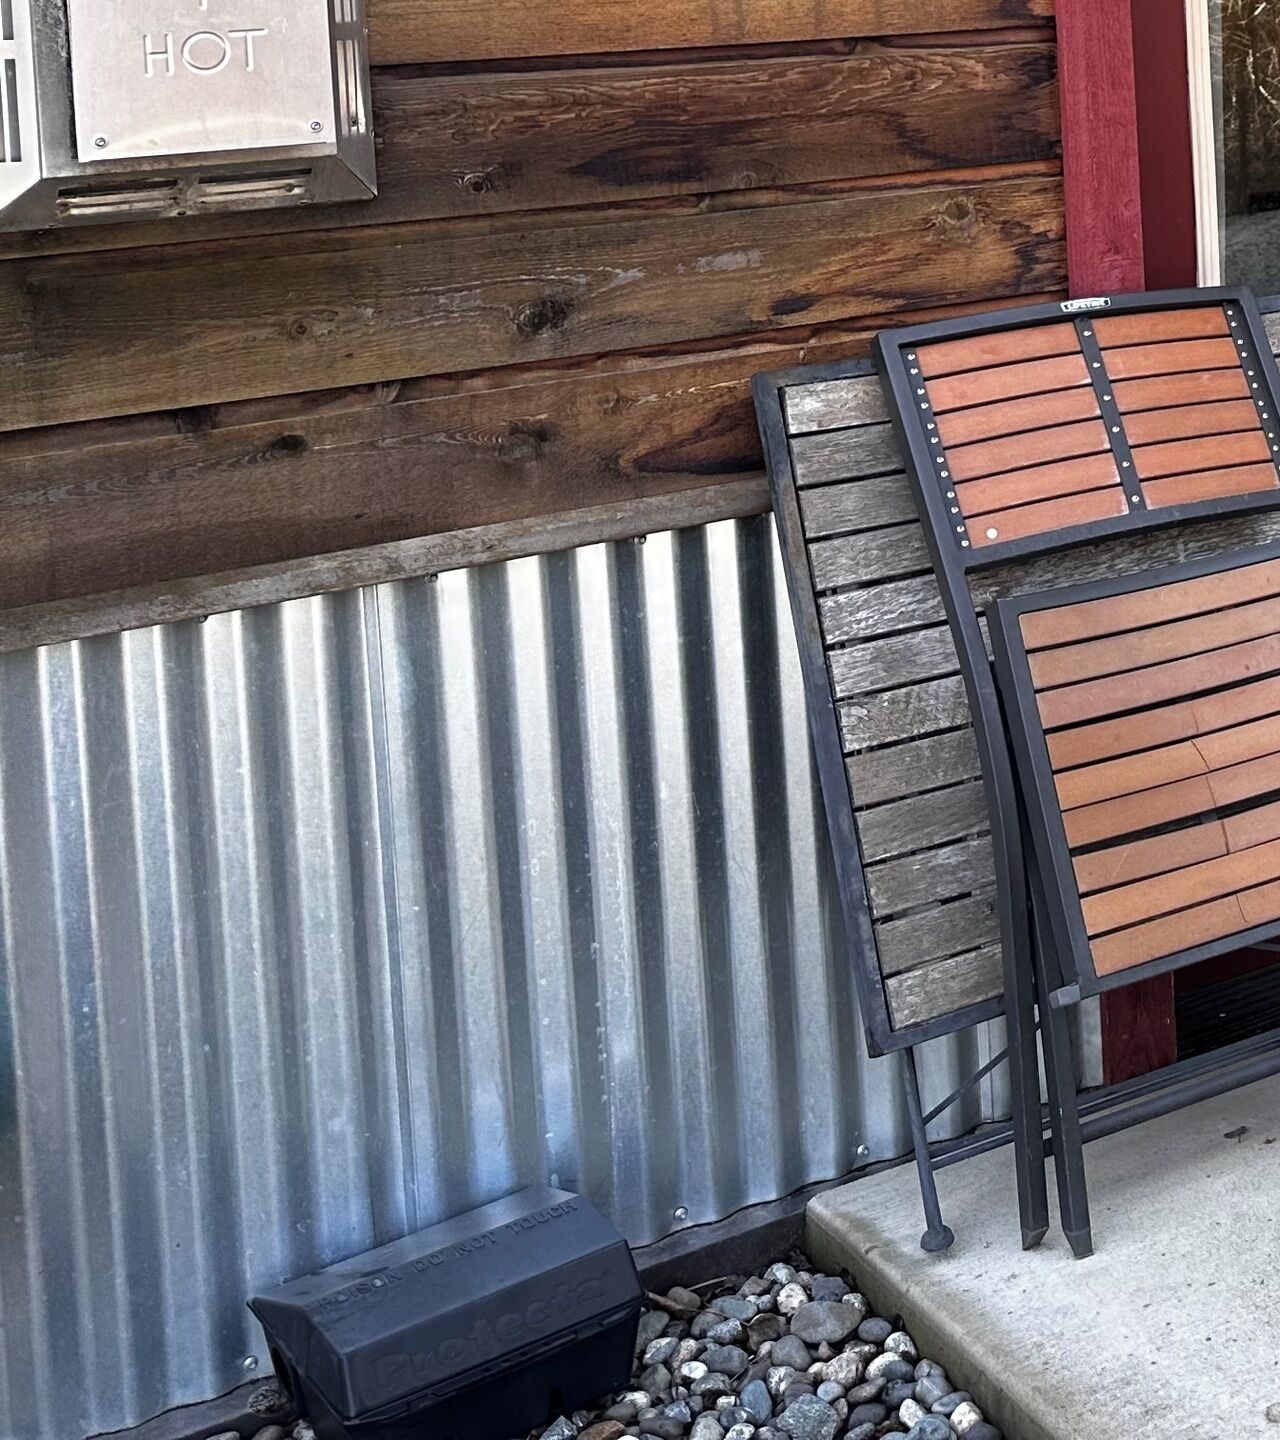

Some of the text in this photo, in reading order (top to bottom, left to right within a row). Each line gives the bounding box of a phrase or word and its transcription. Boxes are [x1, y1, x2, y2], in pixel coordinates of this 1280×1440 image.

[142, 27, 268, 78] HOT
[317, 1201, 579, 1310] POISON DO NOT TOUCH
[372, 1276, 606, 1388] Protecta
